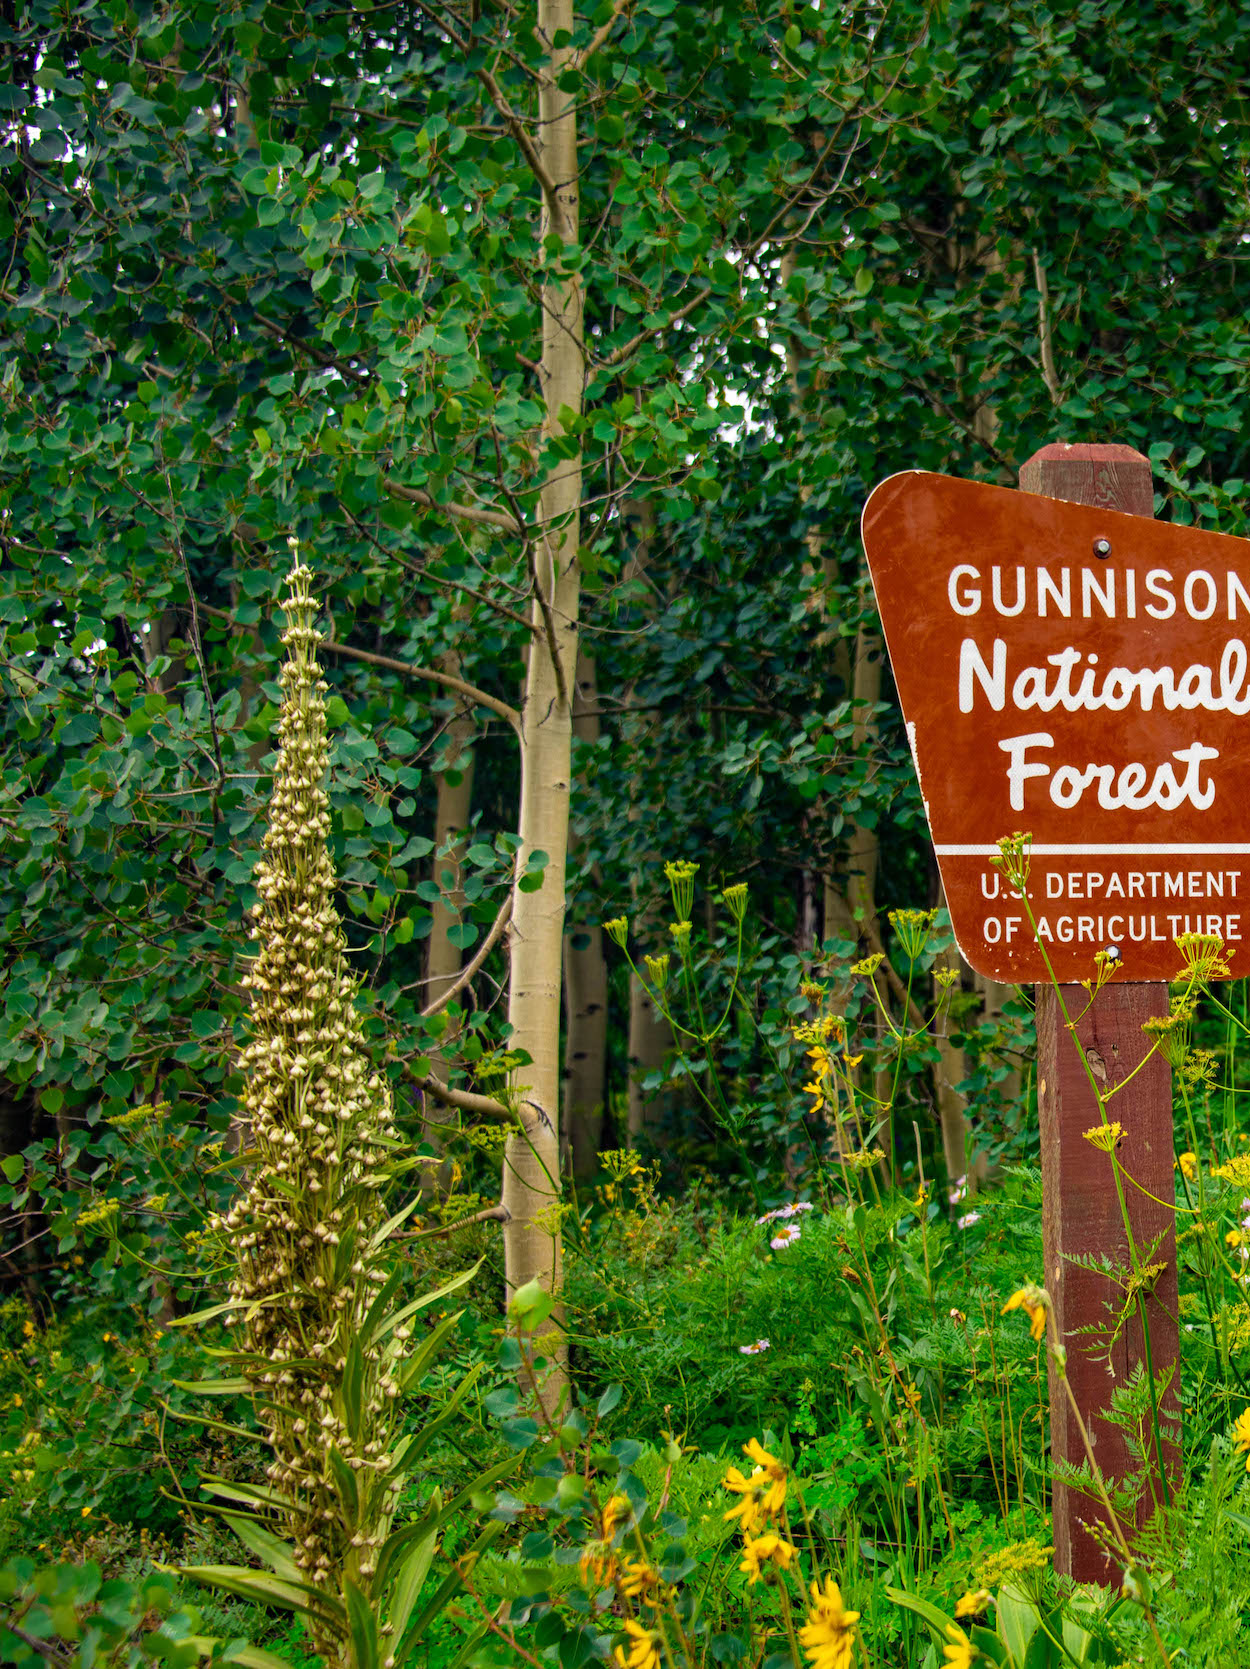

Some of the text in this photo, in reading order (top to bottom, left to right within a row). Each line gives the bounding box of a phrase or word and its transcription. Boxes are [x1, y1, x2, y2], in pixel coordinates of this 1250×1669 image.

[997, 732, 1220, 812] Forest
[1046, 871, 1242, 899] DEPARTMENT
[983, 914, 1242, 944] OF AGRICULTURE
